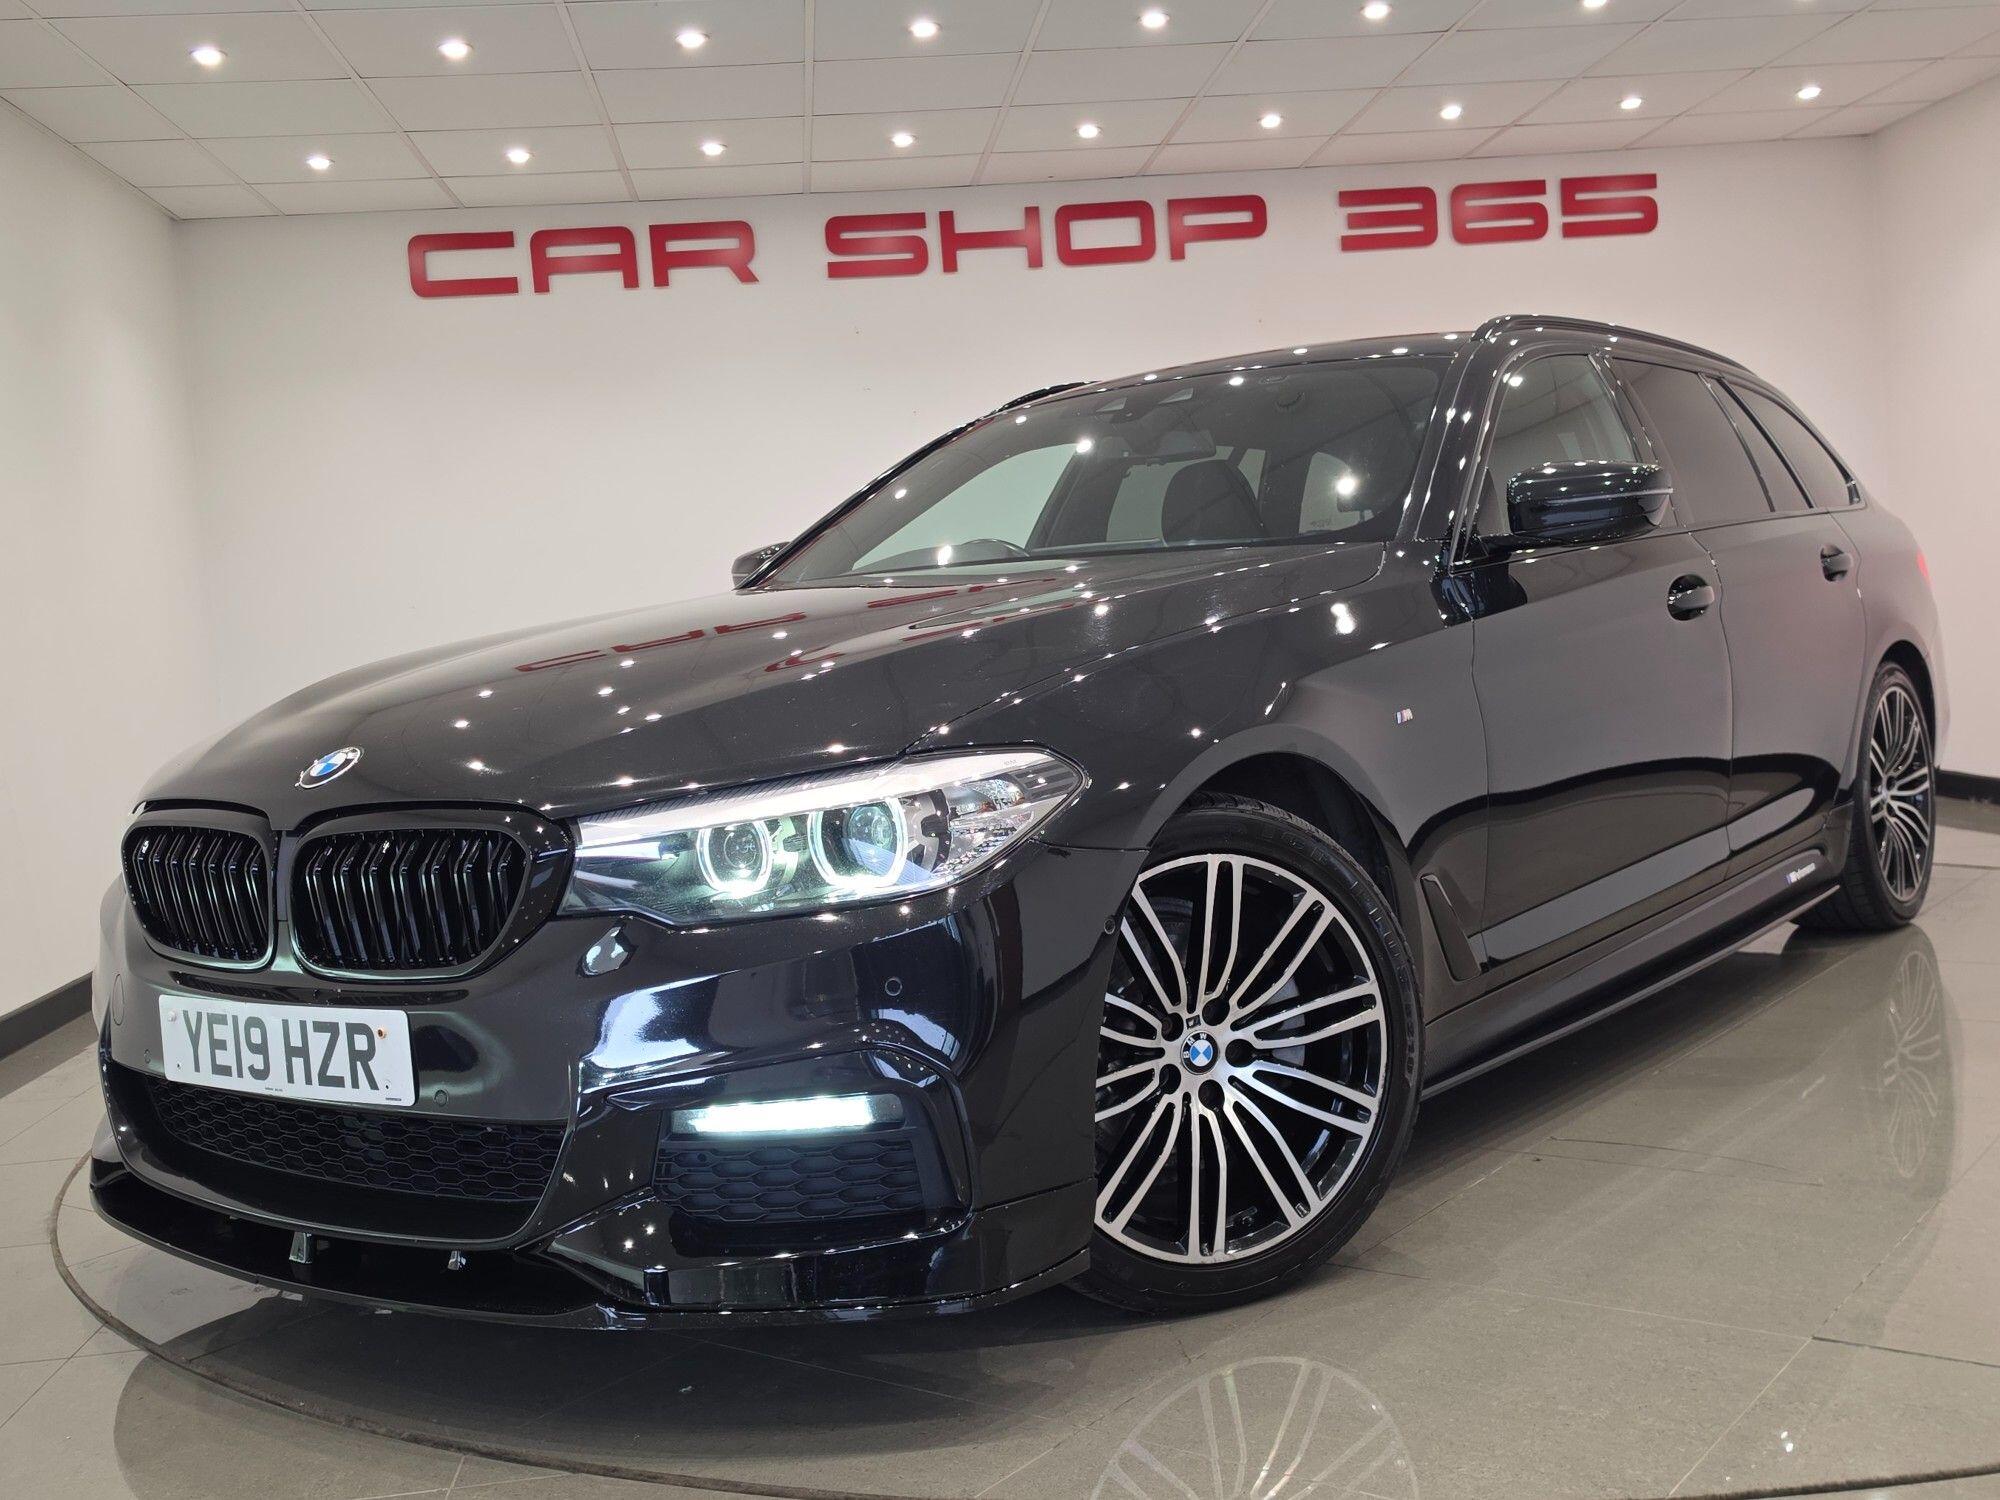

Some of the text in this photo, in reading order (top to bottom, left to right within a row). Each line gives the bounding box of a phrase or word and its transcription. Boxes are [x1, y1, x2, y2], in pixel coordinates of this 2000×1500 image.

[408, 173, 1659, 298] CAR SHOP 365
[182, 1009, 380, 1091] YE19 HZR
[1183, 1032, 1207, 1059] BMW
